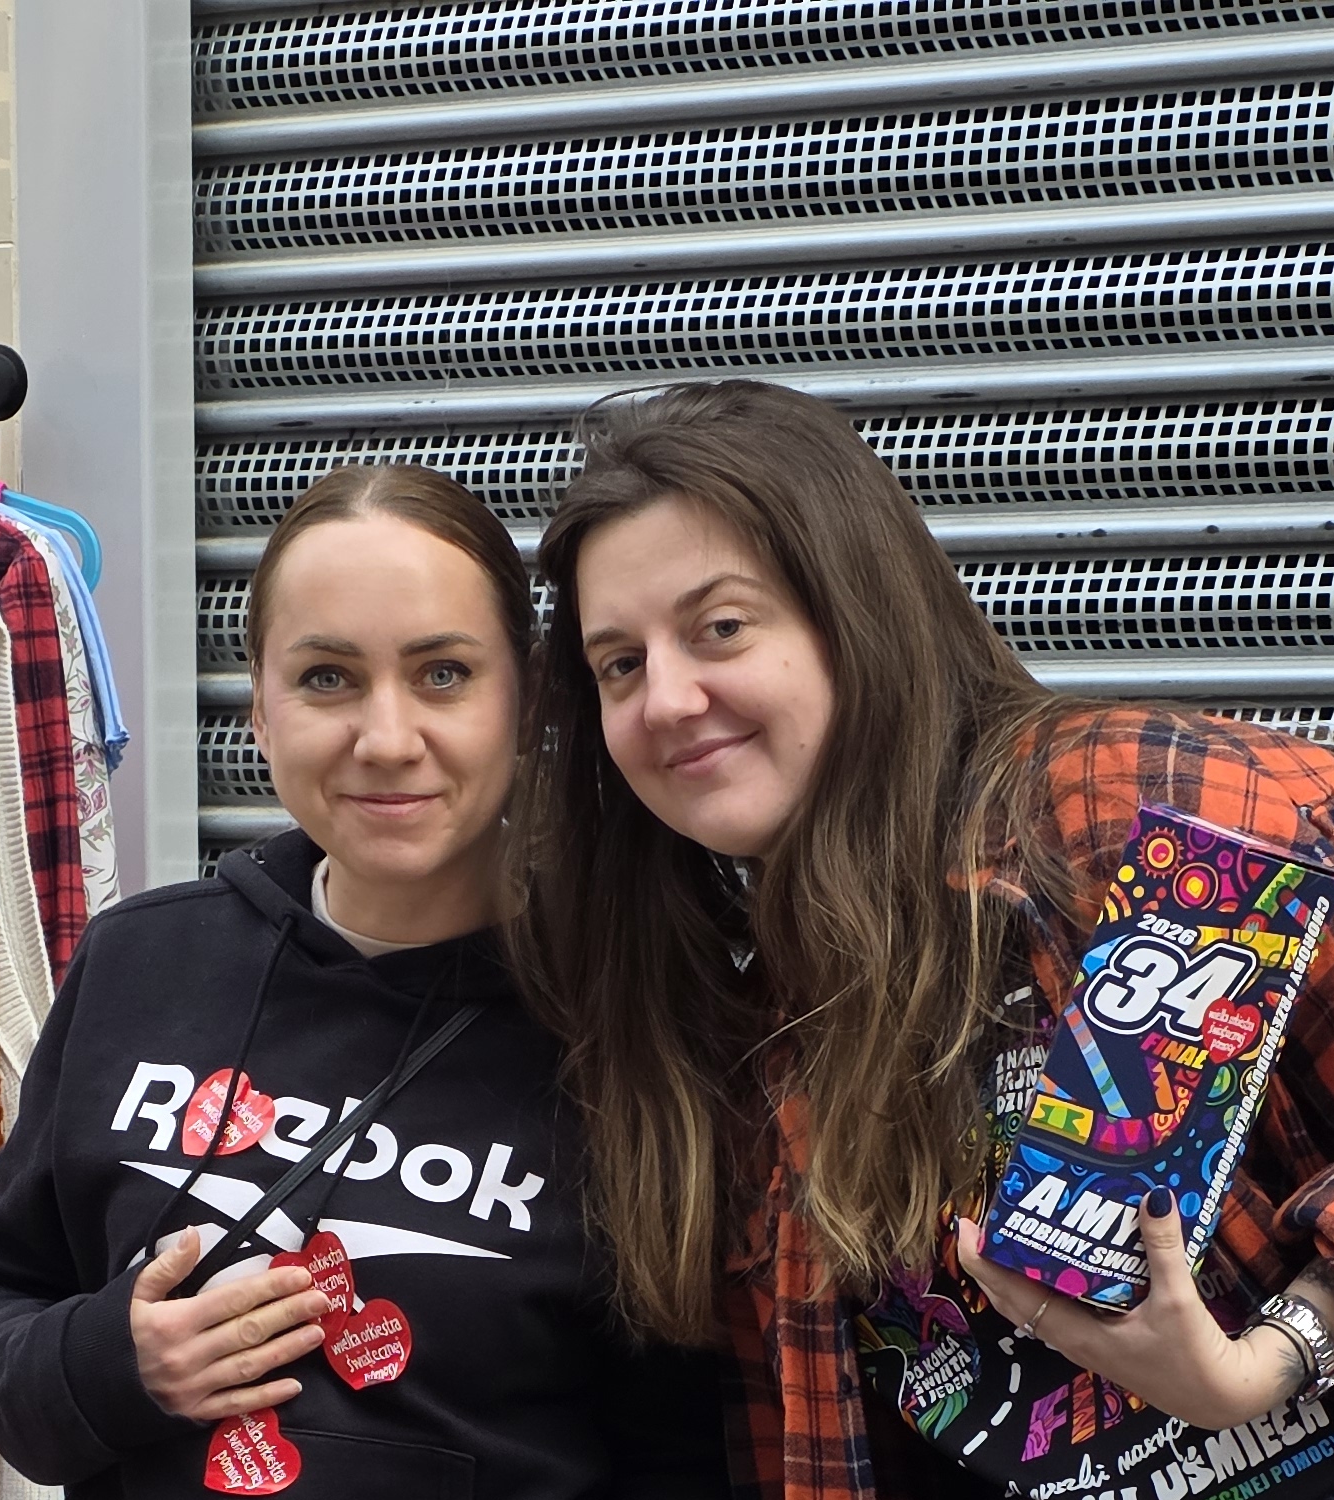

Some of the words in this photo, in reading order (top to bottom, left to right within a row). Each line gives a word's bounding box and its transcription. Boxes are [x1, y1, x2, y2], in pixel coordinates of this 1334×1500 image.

[1136, 913, 1197, 946] 2026
[1286, 896, 1330, 988] CHOROBY
[1087, 940, 1252, 1037] 34
[1251, 982, 1300, 1085] PRZEWODU
[111, 1062, 544, 1231] Rebok
[1197, 1086, 1259, 1228] POKARMOWEGO
[1018, 1174, 1067, 1219] A
[1004, 1211, 1093, 1258] ROBIMY
[308, 1246, 346, 1274] orkiestra
[330, 1328, 361, 1356] wielka
[360, 1316, 403, 1343] orkiestra
[906, 1365, 925, 1385] DO
[928, 1369, 974, 1404] JEDEN
[238, 1413, 267, 1443] wielka
[256, 1441, 286, 1484] orkiestra
